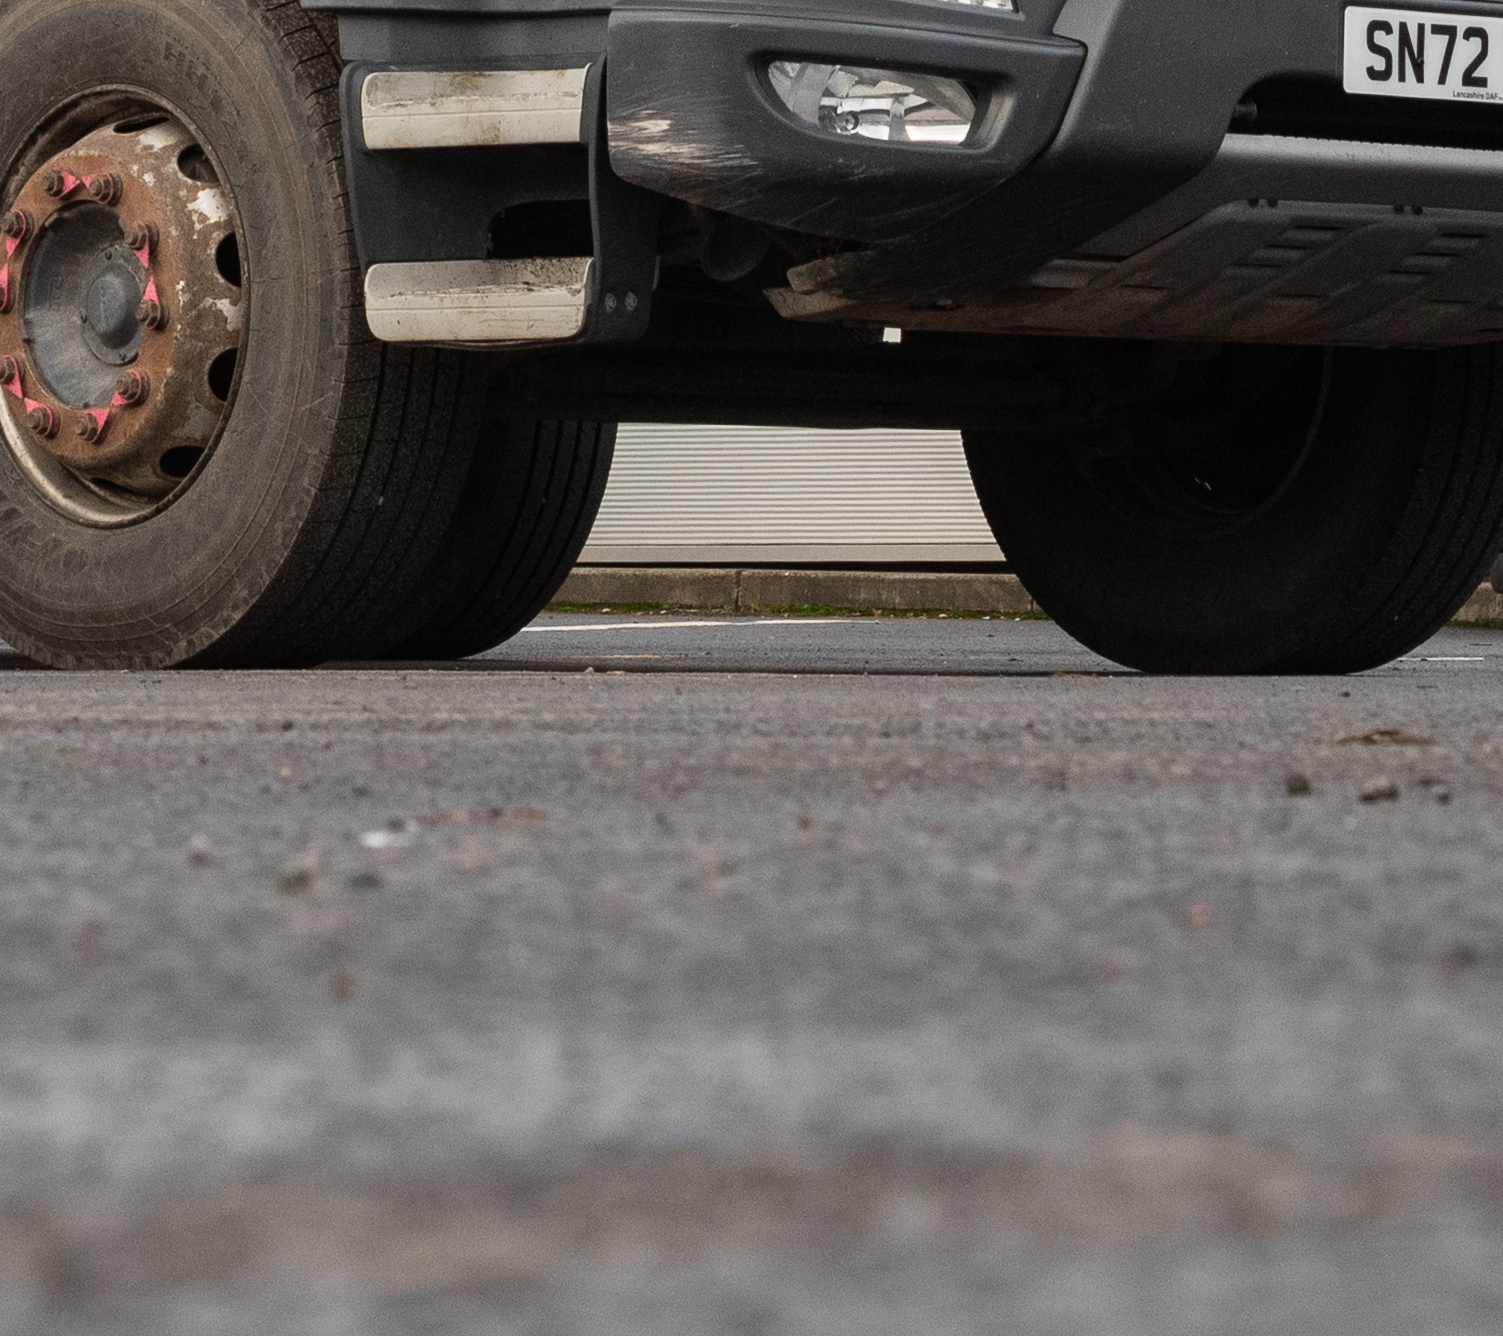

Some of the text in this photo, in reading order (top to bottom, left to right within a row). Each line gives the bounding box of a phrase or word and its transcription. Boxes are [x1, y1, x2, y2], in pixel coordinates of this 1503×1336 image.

[1365, 19, 1489, 89] SN72
[1452, 89, 1485, 101] Lancashire
[1485, 92, 1499, 101] DAF
